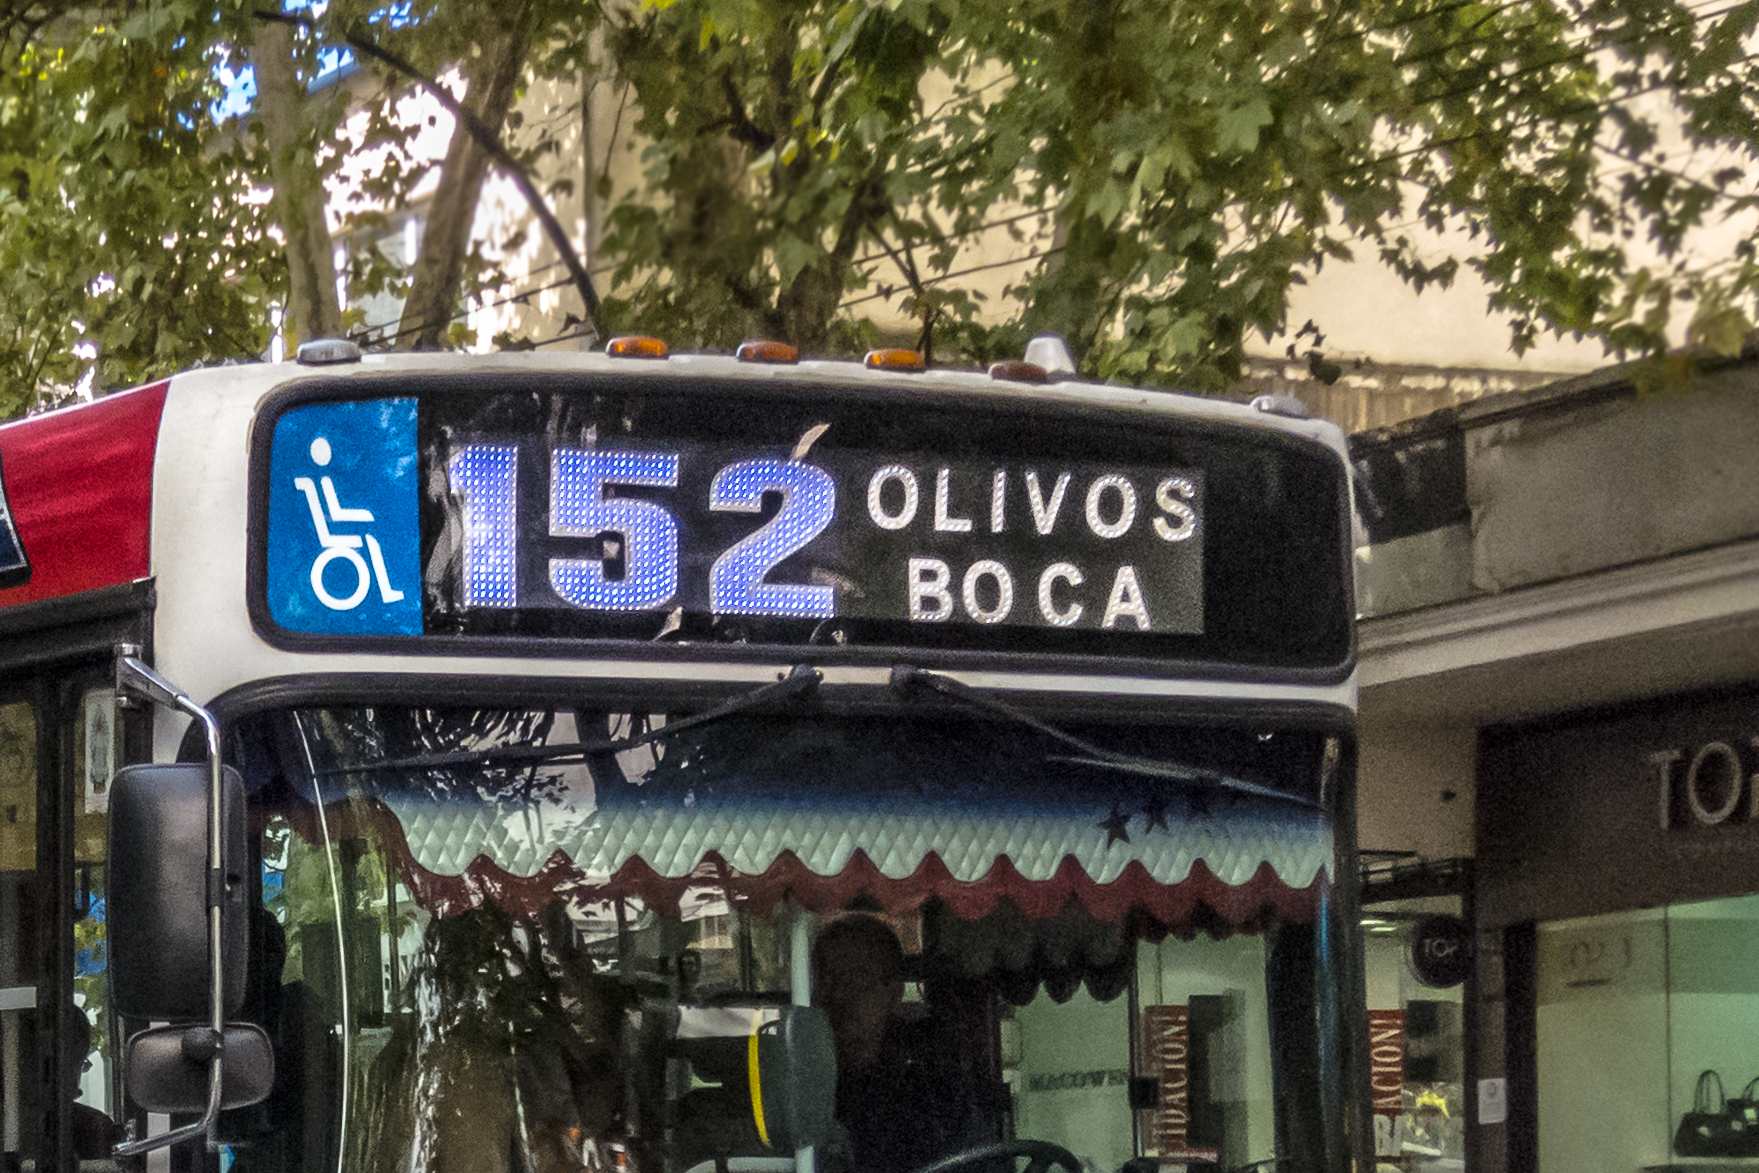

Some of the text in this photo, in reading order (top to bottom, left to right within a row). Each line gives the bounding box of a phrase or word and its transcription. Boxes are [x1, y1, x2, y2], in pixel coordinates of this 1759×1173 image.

[448, 444, 1197, 619] 152 OLIVOS
[908, 557, 1152, 631] BOCA
[1649, 735, 1759, 829] TO
